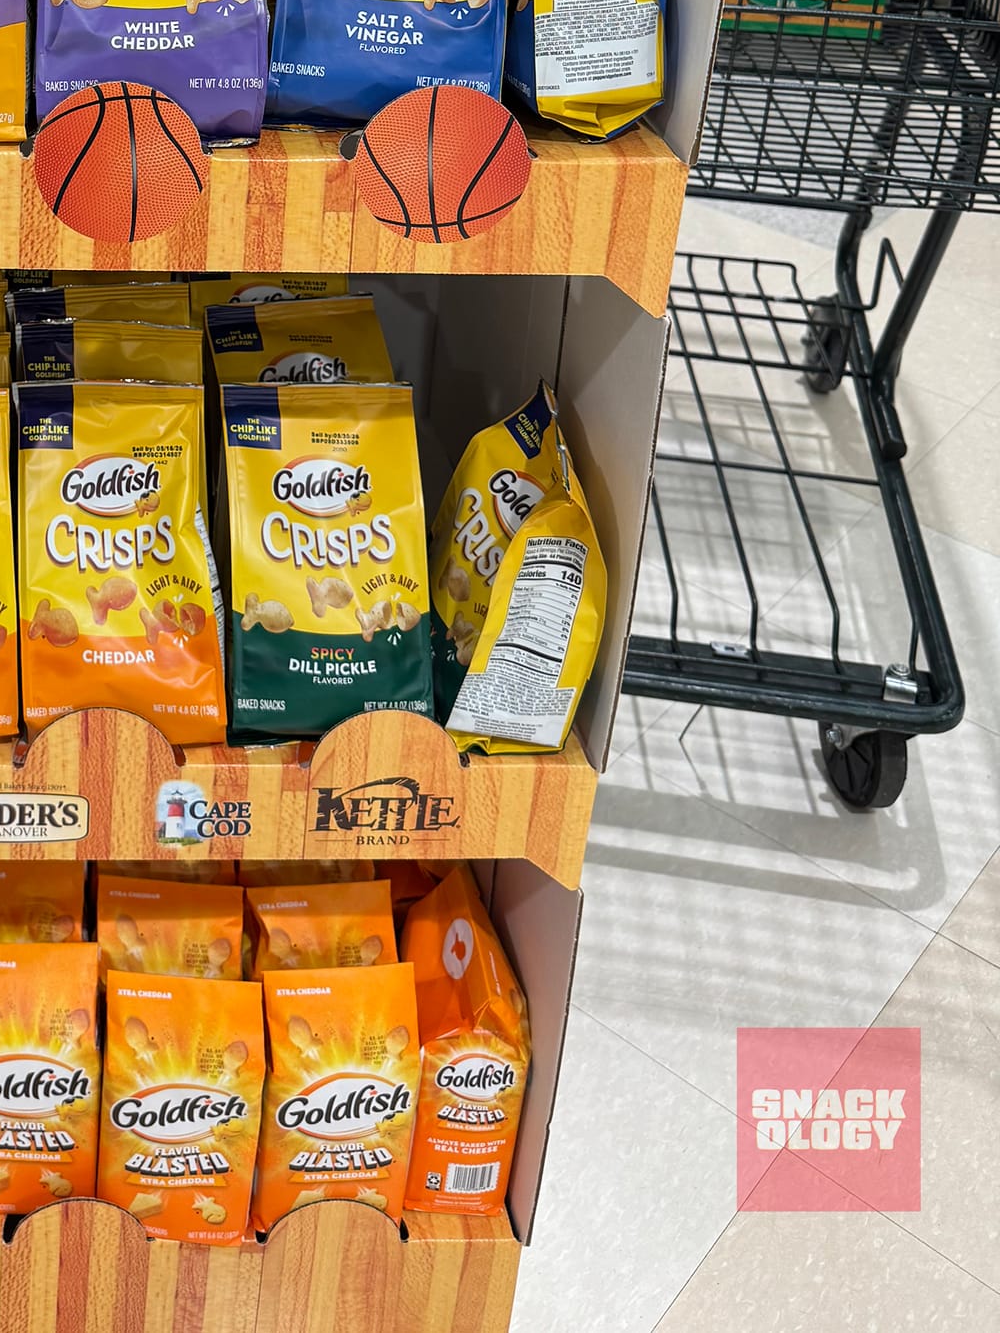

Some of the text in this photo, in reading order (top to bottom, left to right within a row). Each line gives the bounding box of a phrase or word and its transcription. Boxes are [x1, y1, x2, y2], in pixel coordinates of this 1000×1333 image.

[356, 10, 414, 28] SALT &
[124, 21, 180, 36] WHITE
[345, 23, 424, 46] VINEGAR
[110, 34, 195, 51] CHEDDAR
[271, 62, 325, 77] BAKED SNACKS
[189, 77, 264, 90] NET WT 4.8 OZ (136g)
[62, 464, 161, 501] Goldfish
[274, 465, 371, 501] Goldfish
[565, 539, 586, 554] Facts
[562, 570, 581, 585] 140
[310, 648, 354, 661] SPICY
[288, 658, 377, 676] DILL PICKLE
[189, 801, 251, 819] CAPE
[197, 819, 250, 837] COD
[356, 835, 409, 845] BRAND
[436, 1065, 515, 1091] Goldfish
[112, 1094, 245, 1132] Goldfish
[277, 1083, 408, 1131] Goldfish
[0, 1121, 45, 1130] FLAVOR
[427, 1137, 507, 1148] ALWAYS BAKED WITH
[434, 1144, 499, 1155] REAL CHEESE
[14, 1152, 61, 1161] CHEDDAR
